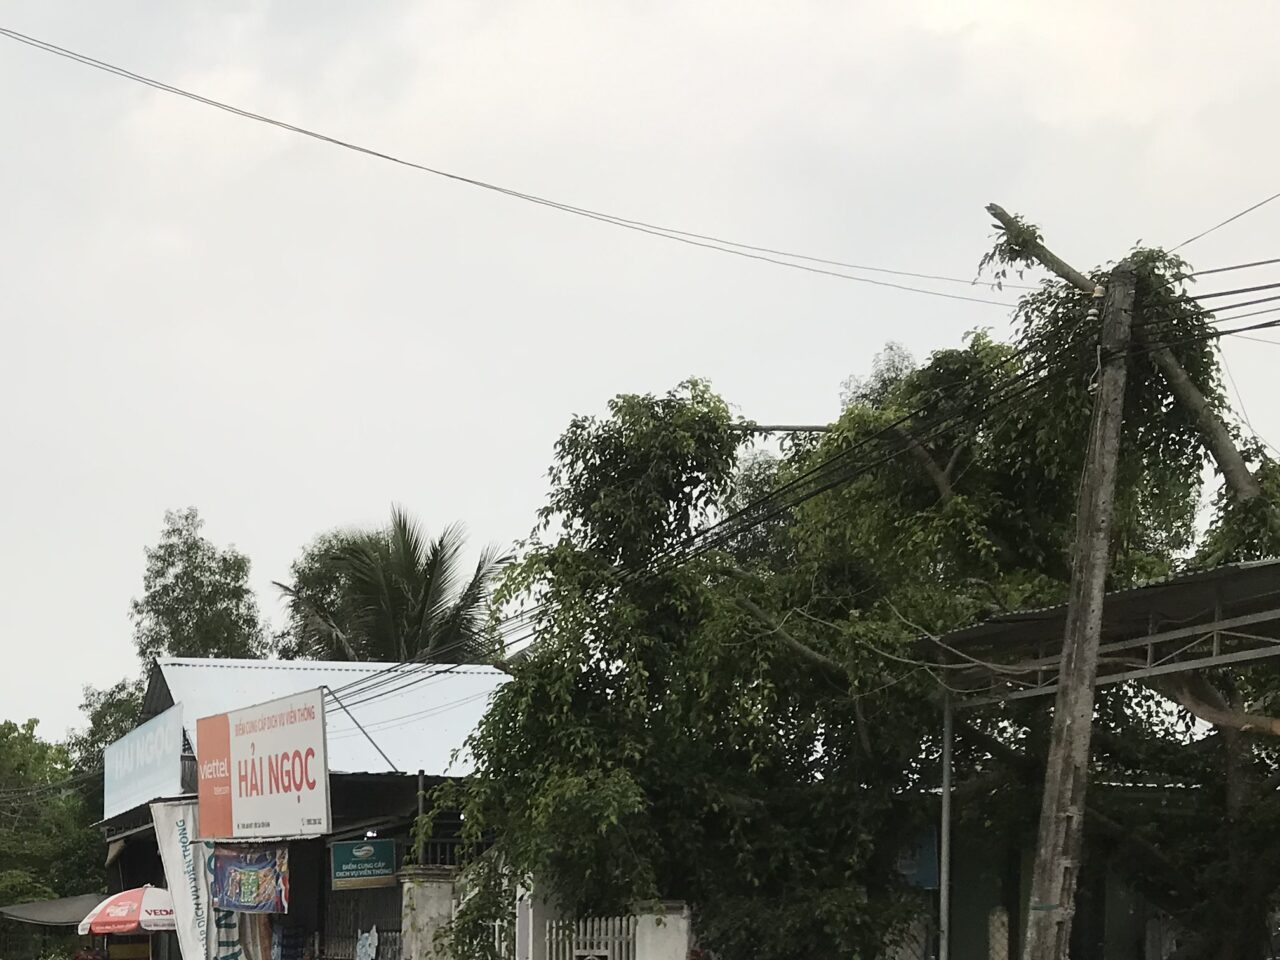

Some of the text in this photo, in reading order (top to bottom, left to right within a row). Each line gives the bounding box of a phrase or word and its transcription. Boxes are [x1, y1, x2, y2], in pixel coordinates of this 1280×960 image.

[199, 758, 229, 779] viettel
[238, 743, 316, 803] HẢI NGỌC
